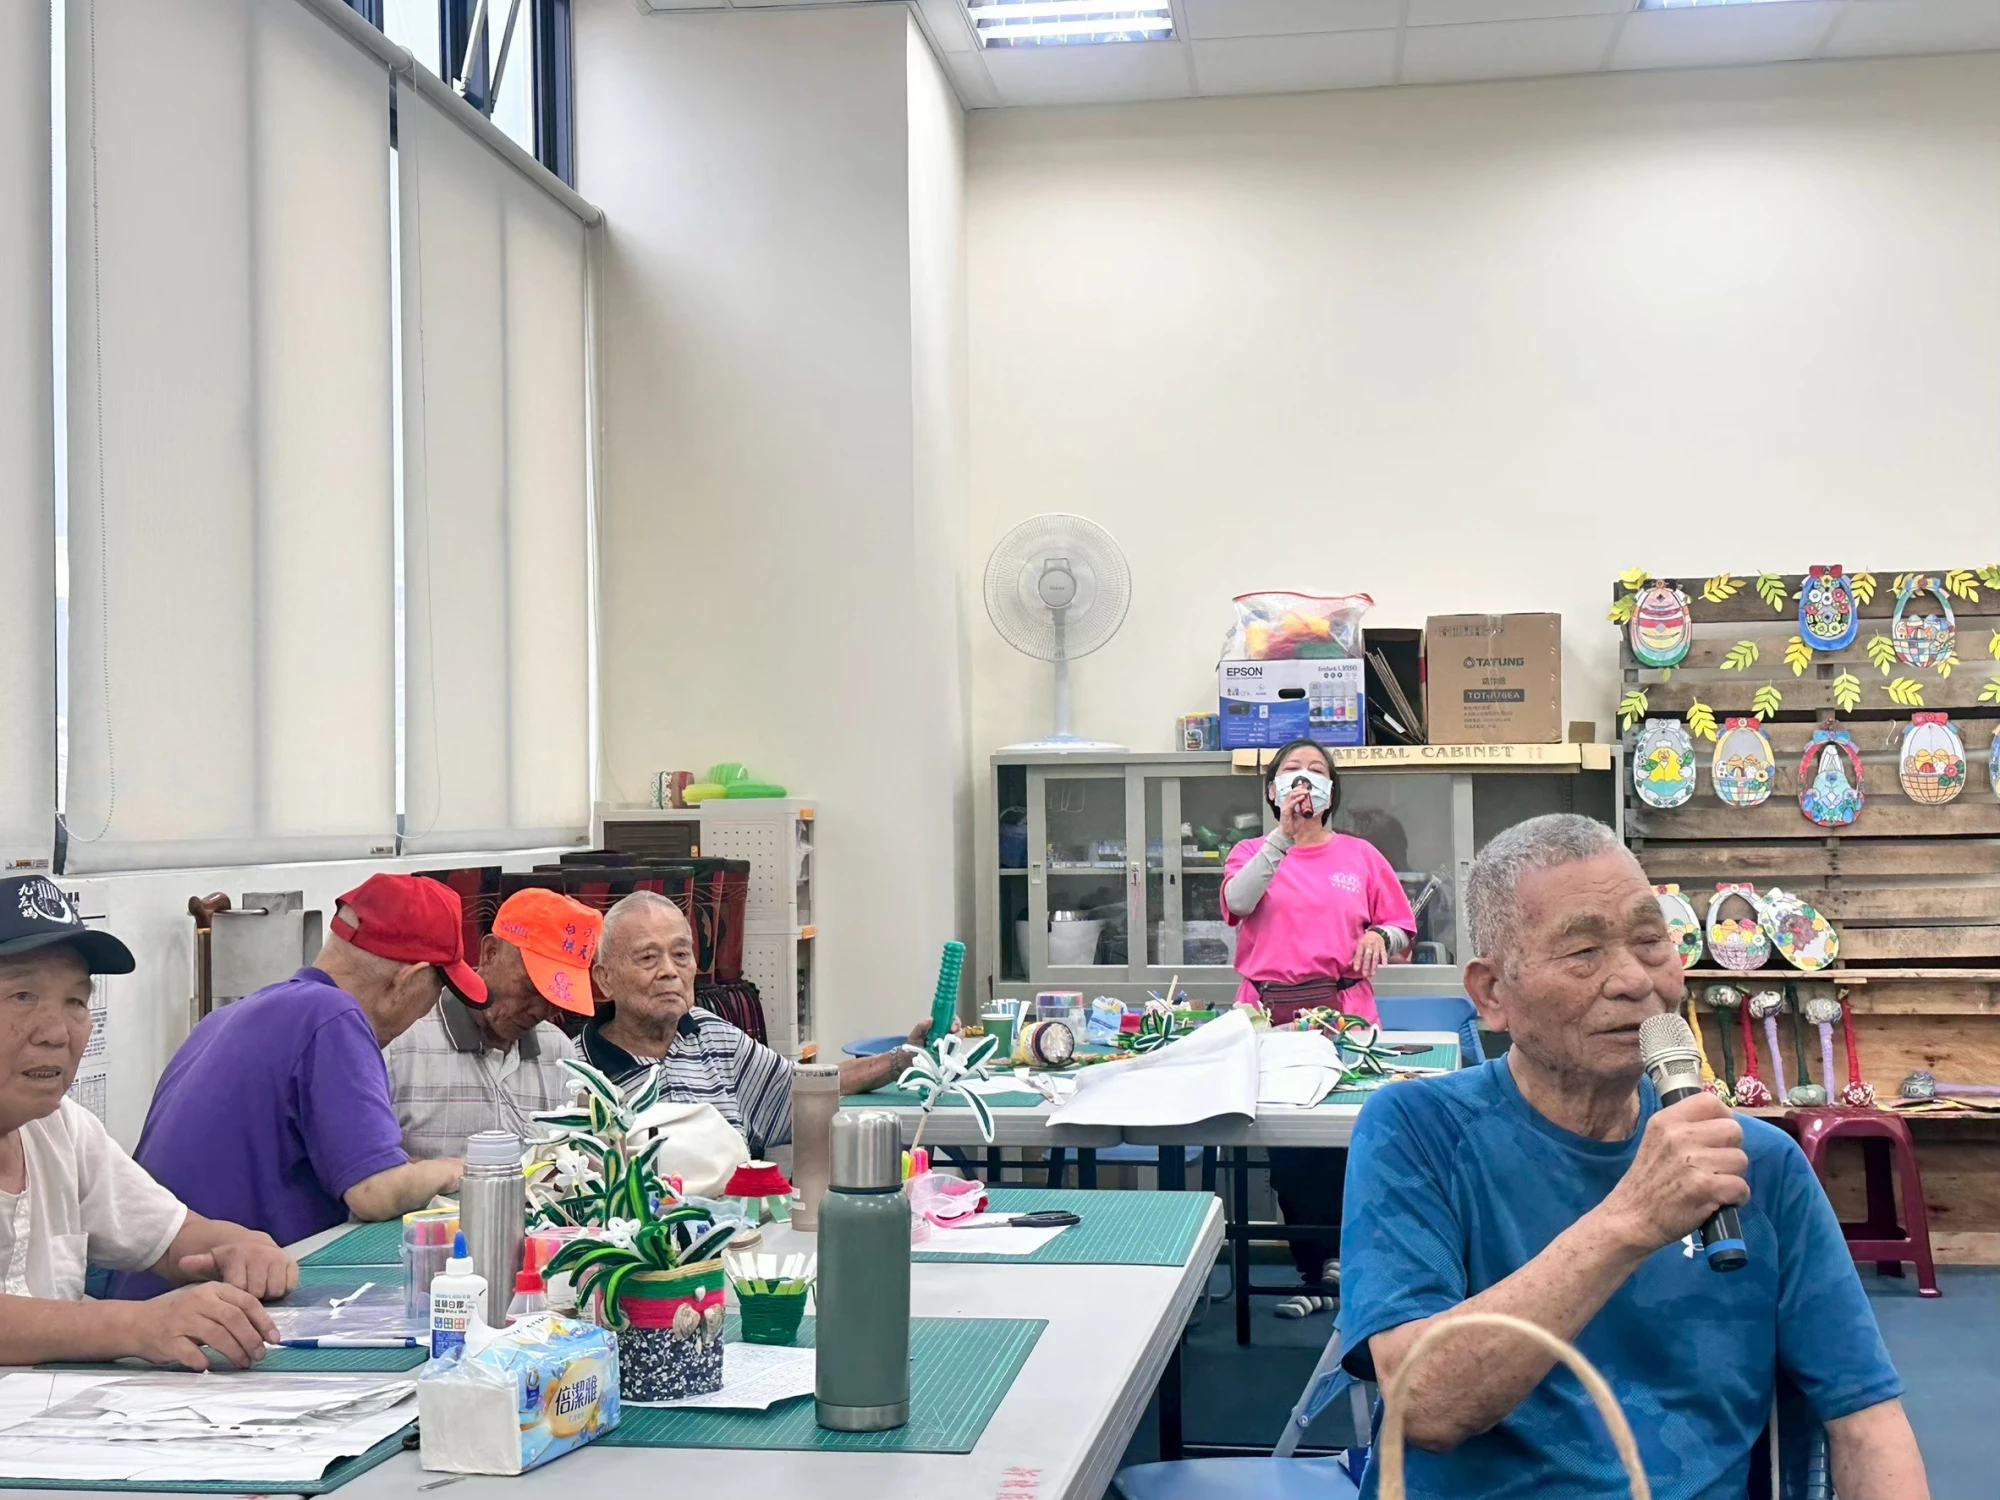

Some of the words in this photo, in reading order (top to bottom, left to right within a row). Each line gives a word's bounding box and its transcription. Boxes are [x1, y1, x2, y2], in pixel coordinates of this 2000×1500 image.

[1477, 657, 1524, 667] TATUNG
[1227, 667, 1263, 677] EPSON
[1331, 747, 1410, 760] ATERAL
[1421, 745, 1514, 758] CABINET
[555, 1375, 598, 1417] 倍潔雅
